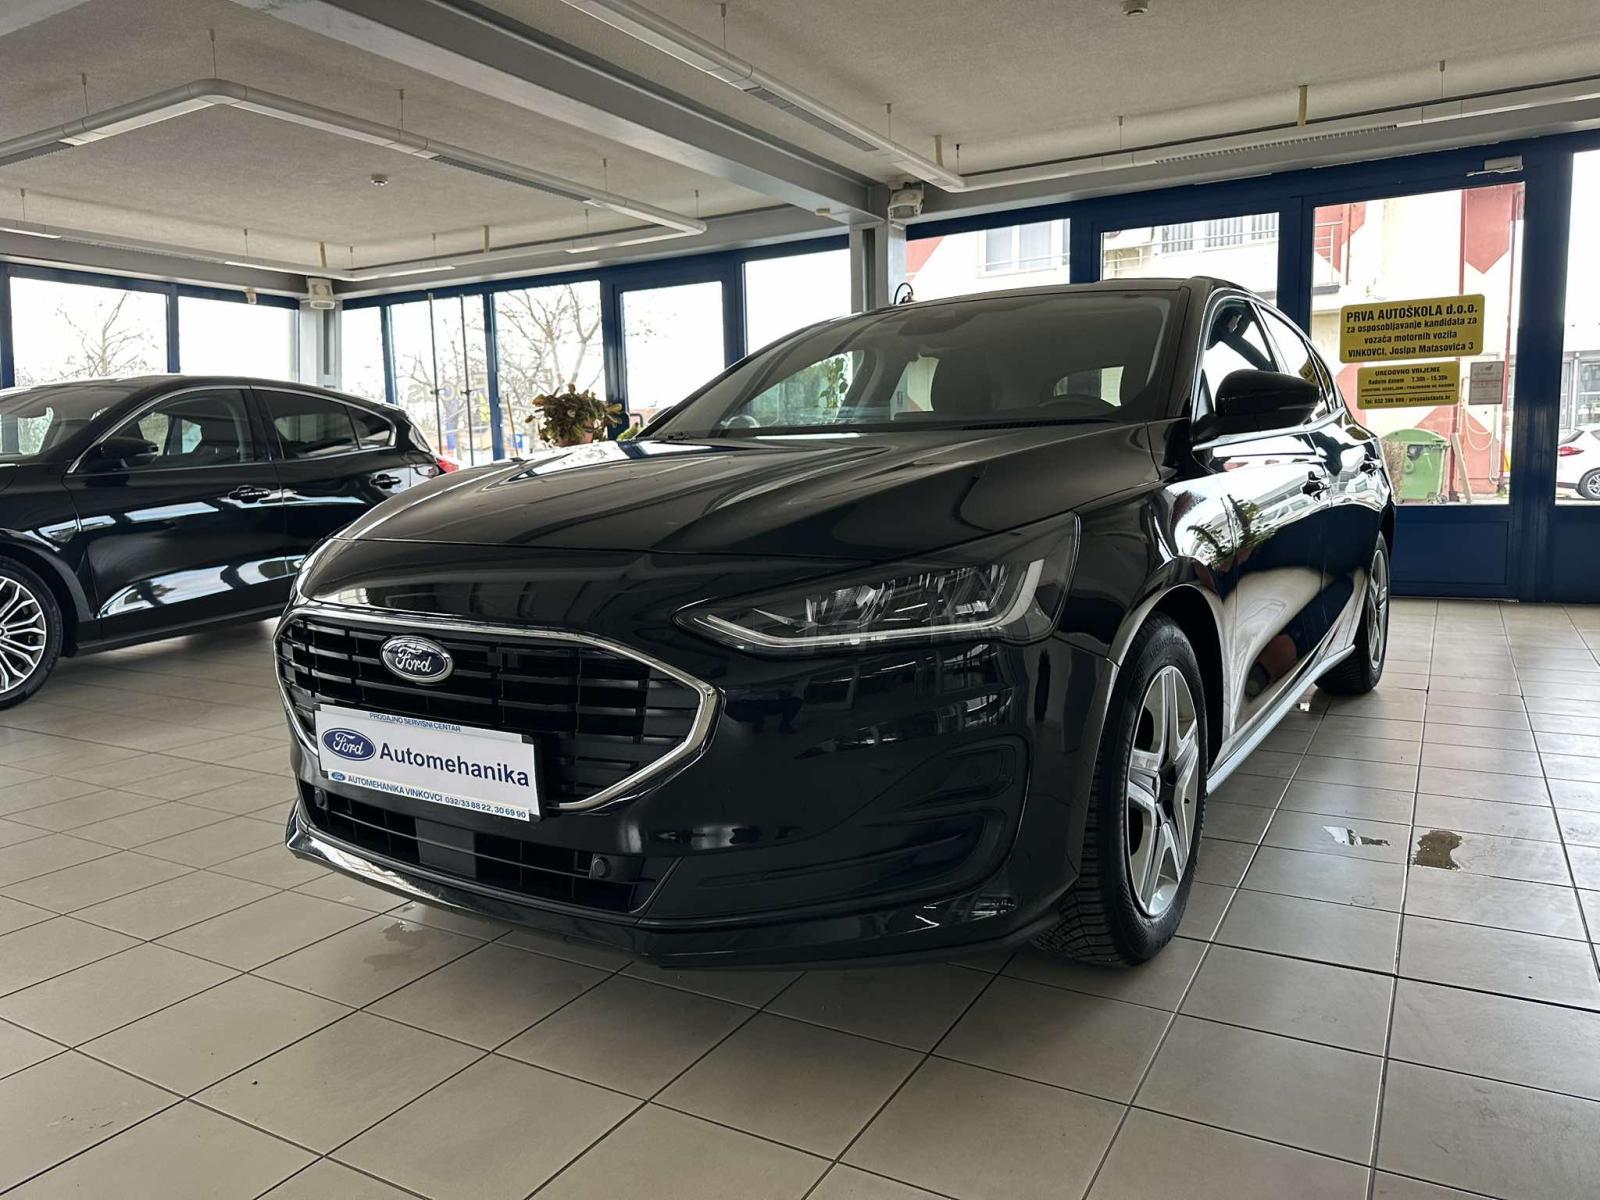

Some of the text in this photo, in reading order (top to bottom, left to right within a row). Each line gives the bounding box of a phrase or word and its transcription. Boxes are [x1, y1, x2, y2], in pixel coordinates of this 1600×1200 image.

[1347, 304, 1477, 322] PRVA AUTOŠKOLA d.o.o.
[1358, 320, 1422, 333] osposobljavanje
[1424, 317, 1465, 328] kandidata
[1467, 317, 1477, 325] za
[1394, 331, 1430, 342] motornih
[1433, 330, 1457, 339] vozila
[1389, 345, 1416, 356] Josipa
[1467, 342, 1474, 350] 3
[395, 645, 432, 673] Ford
[369, 712, 403, 724] PRODAJNO
[434, 722, 461, 732] CENTAR
[333, 732, 529, 787] Ford Automehanika
[348, 775, 404, 794] AUTOMEHANIKA
[406, 788, 442, 802] VINKOVCI
[445, 796, 470, 808] 032/33
[471, 802, 480, 810] 88
[494, 806, 504, 814] 30
[505, 808, 515, 816] 69
